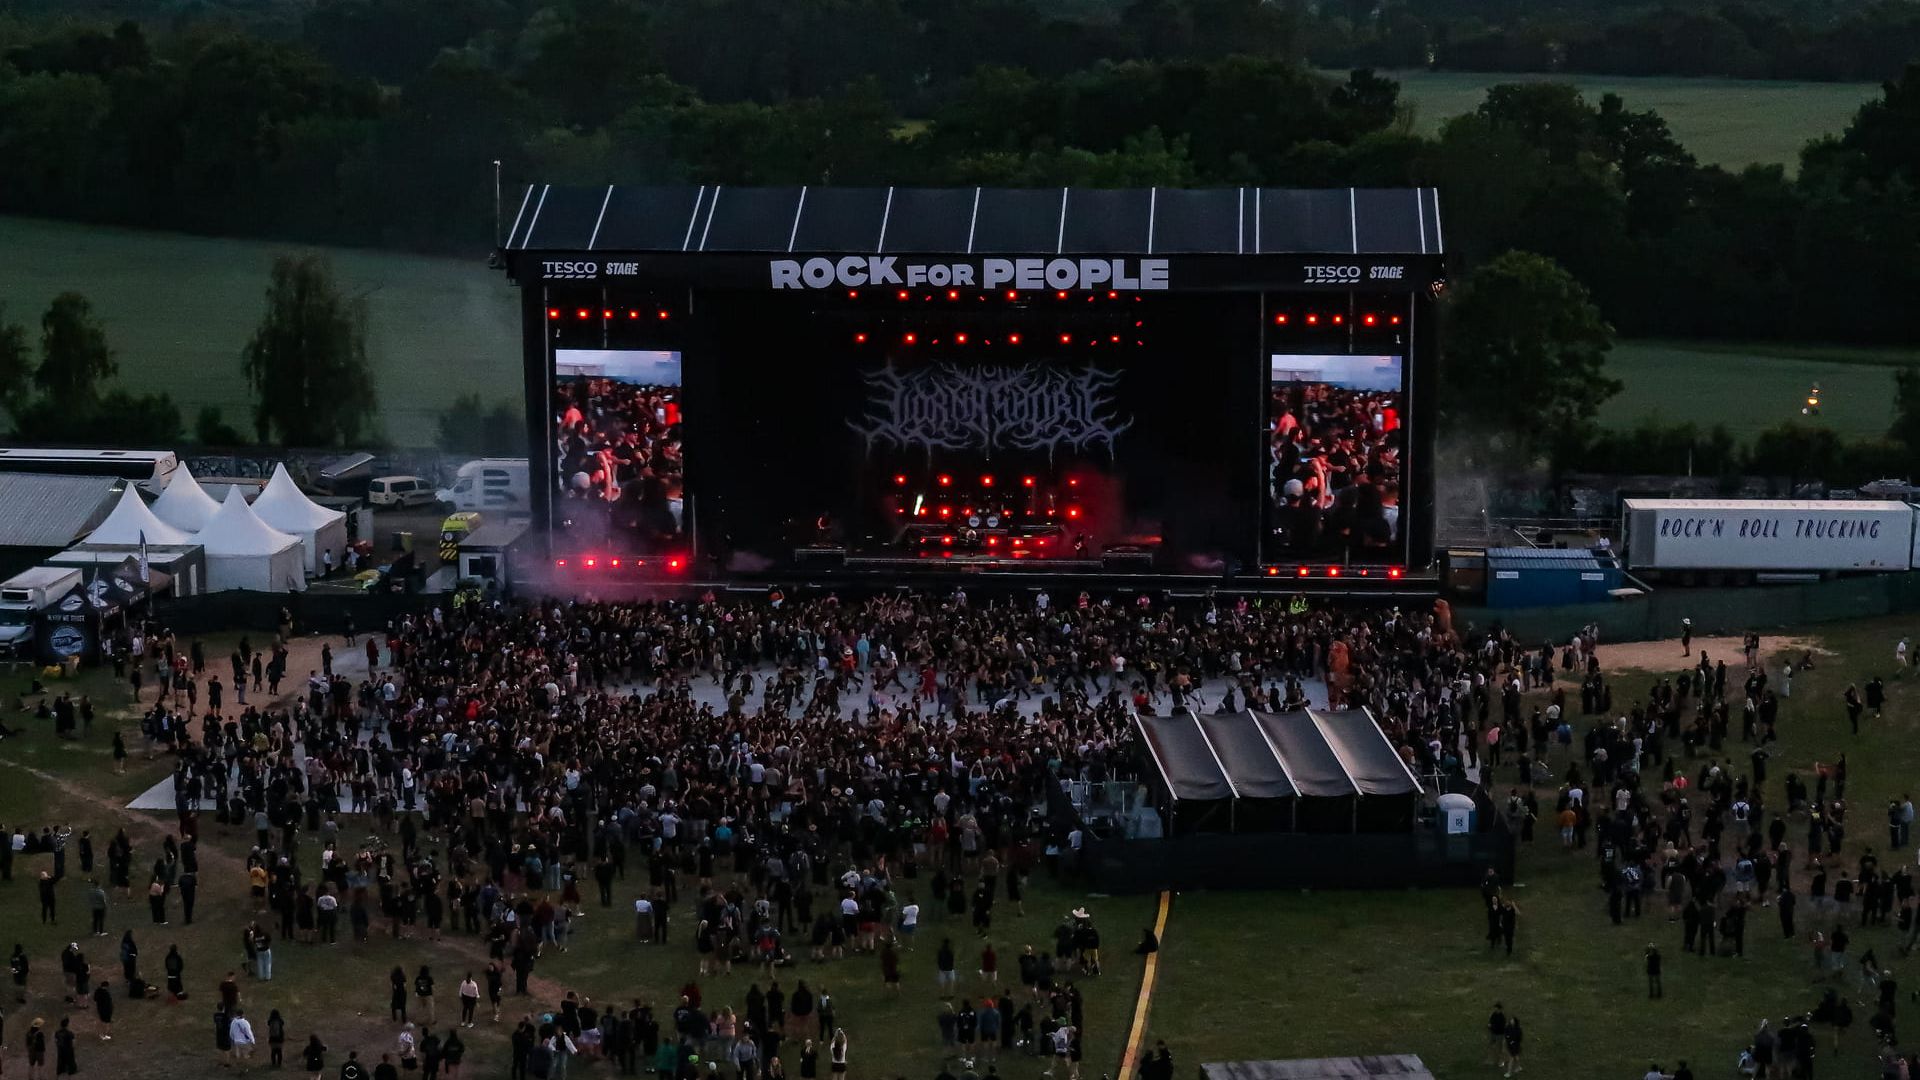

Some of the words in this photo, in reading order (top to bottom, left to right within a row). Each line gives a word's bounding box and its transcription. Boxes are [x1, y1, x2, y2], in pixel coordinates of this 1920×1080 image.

[542, 261, 598, 274] TESCO
[606, 262, 639, 275] STAGE
[770, 256, 903, 290] ROCK
[907, 264, 975, 287] FOR
[983, 259, 1169, 290] PEOPLE
[1303, 266, 1361, 278] TESCO
[1369, 266, 1404, 279] STAGE
[1661, 518, 1725, 538] ROCK'N
[1739, 518, 1780, 539] ROLL
[1795, 519, 1882, 539] TRUCKING
